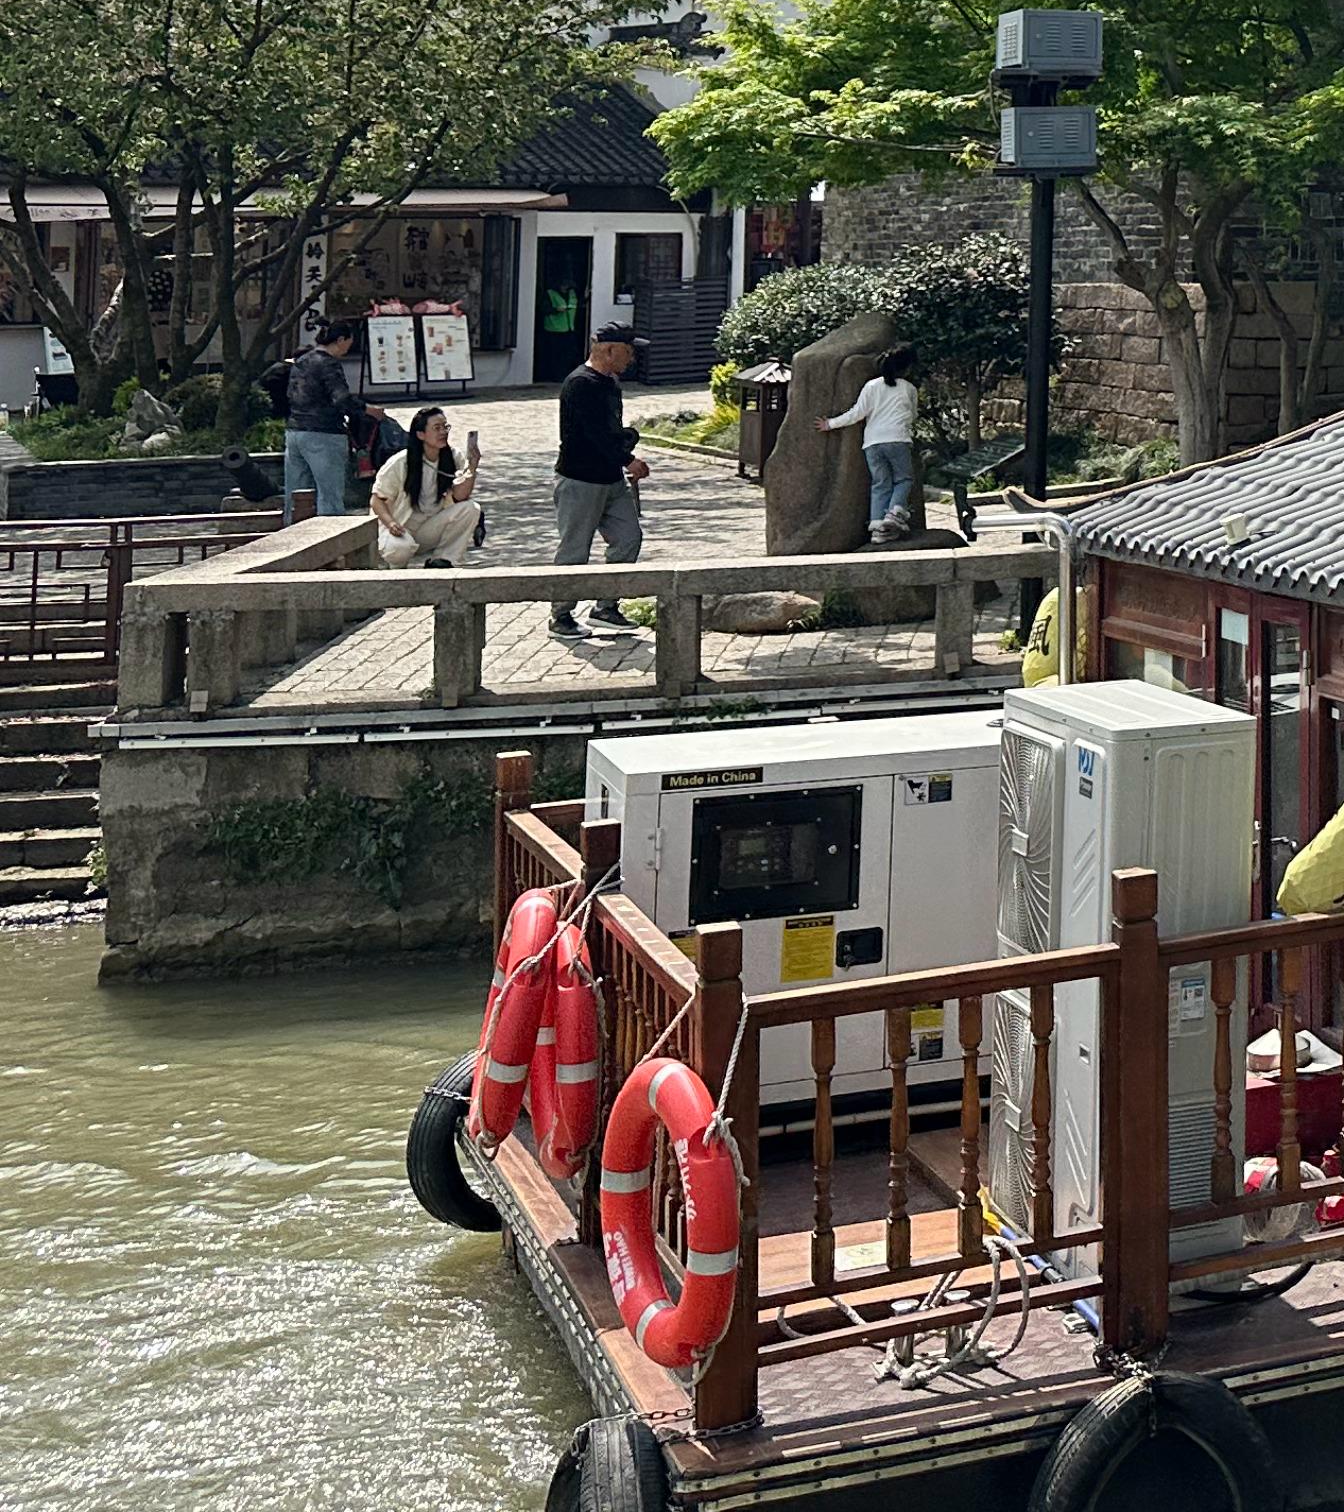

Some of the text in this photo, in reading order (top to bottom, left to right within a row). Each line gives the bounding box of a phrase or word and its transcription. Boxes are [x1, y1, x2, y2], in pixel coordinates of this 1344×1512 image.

[670, 771, 756, 787] Made in China
